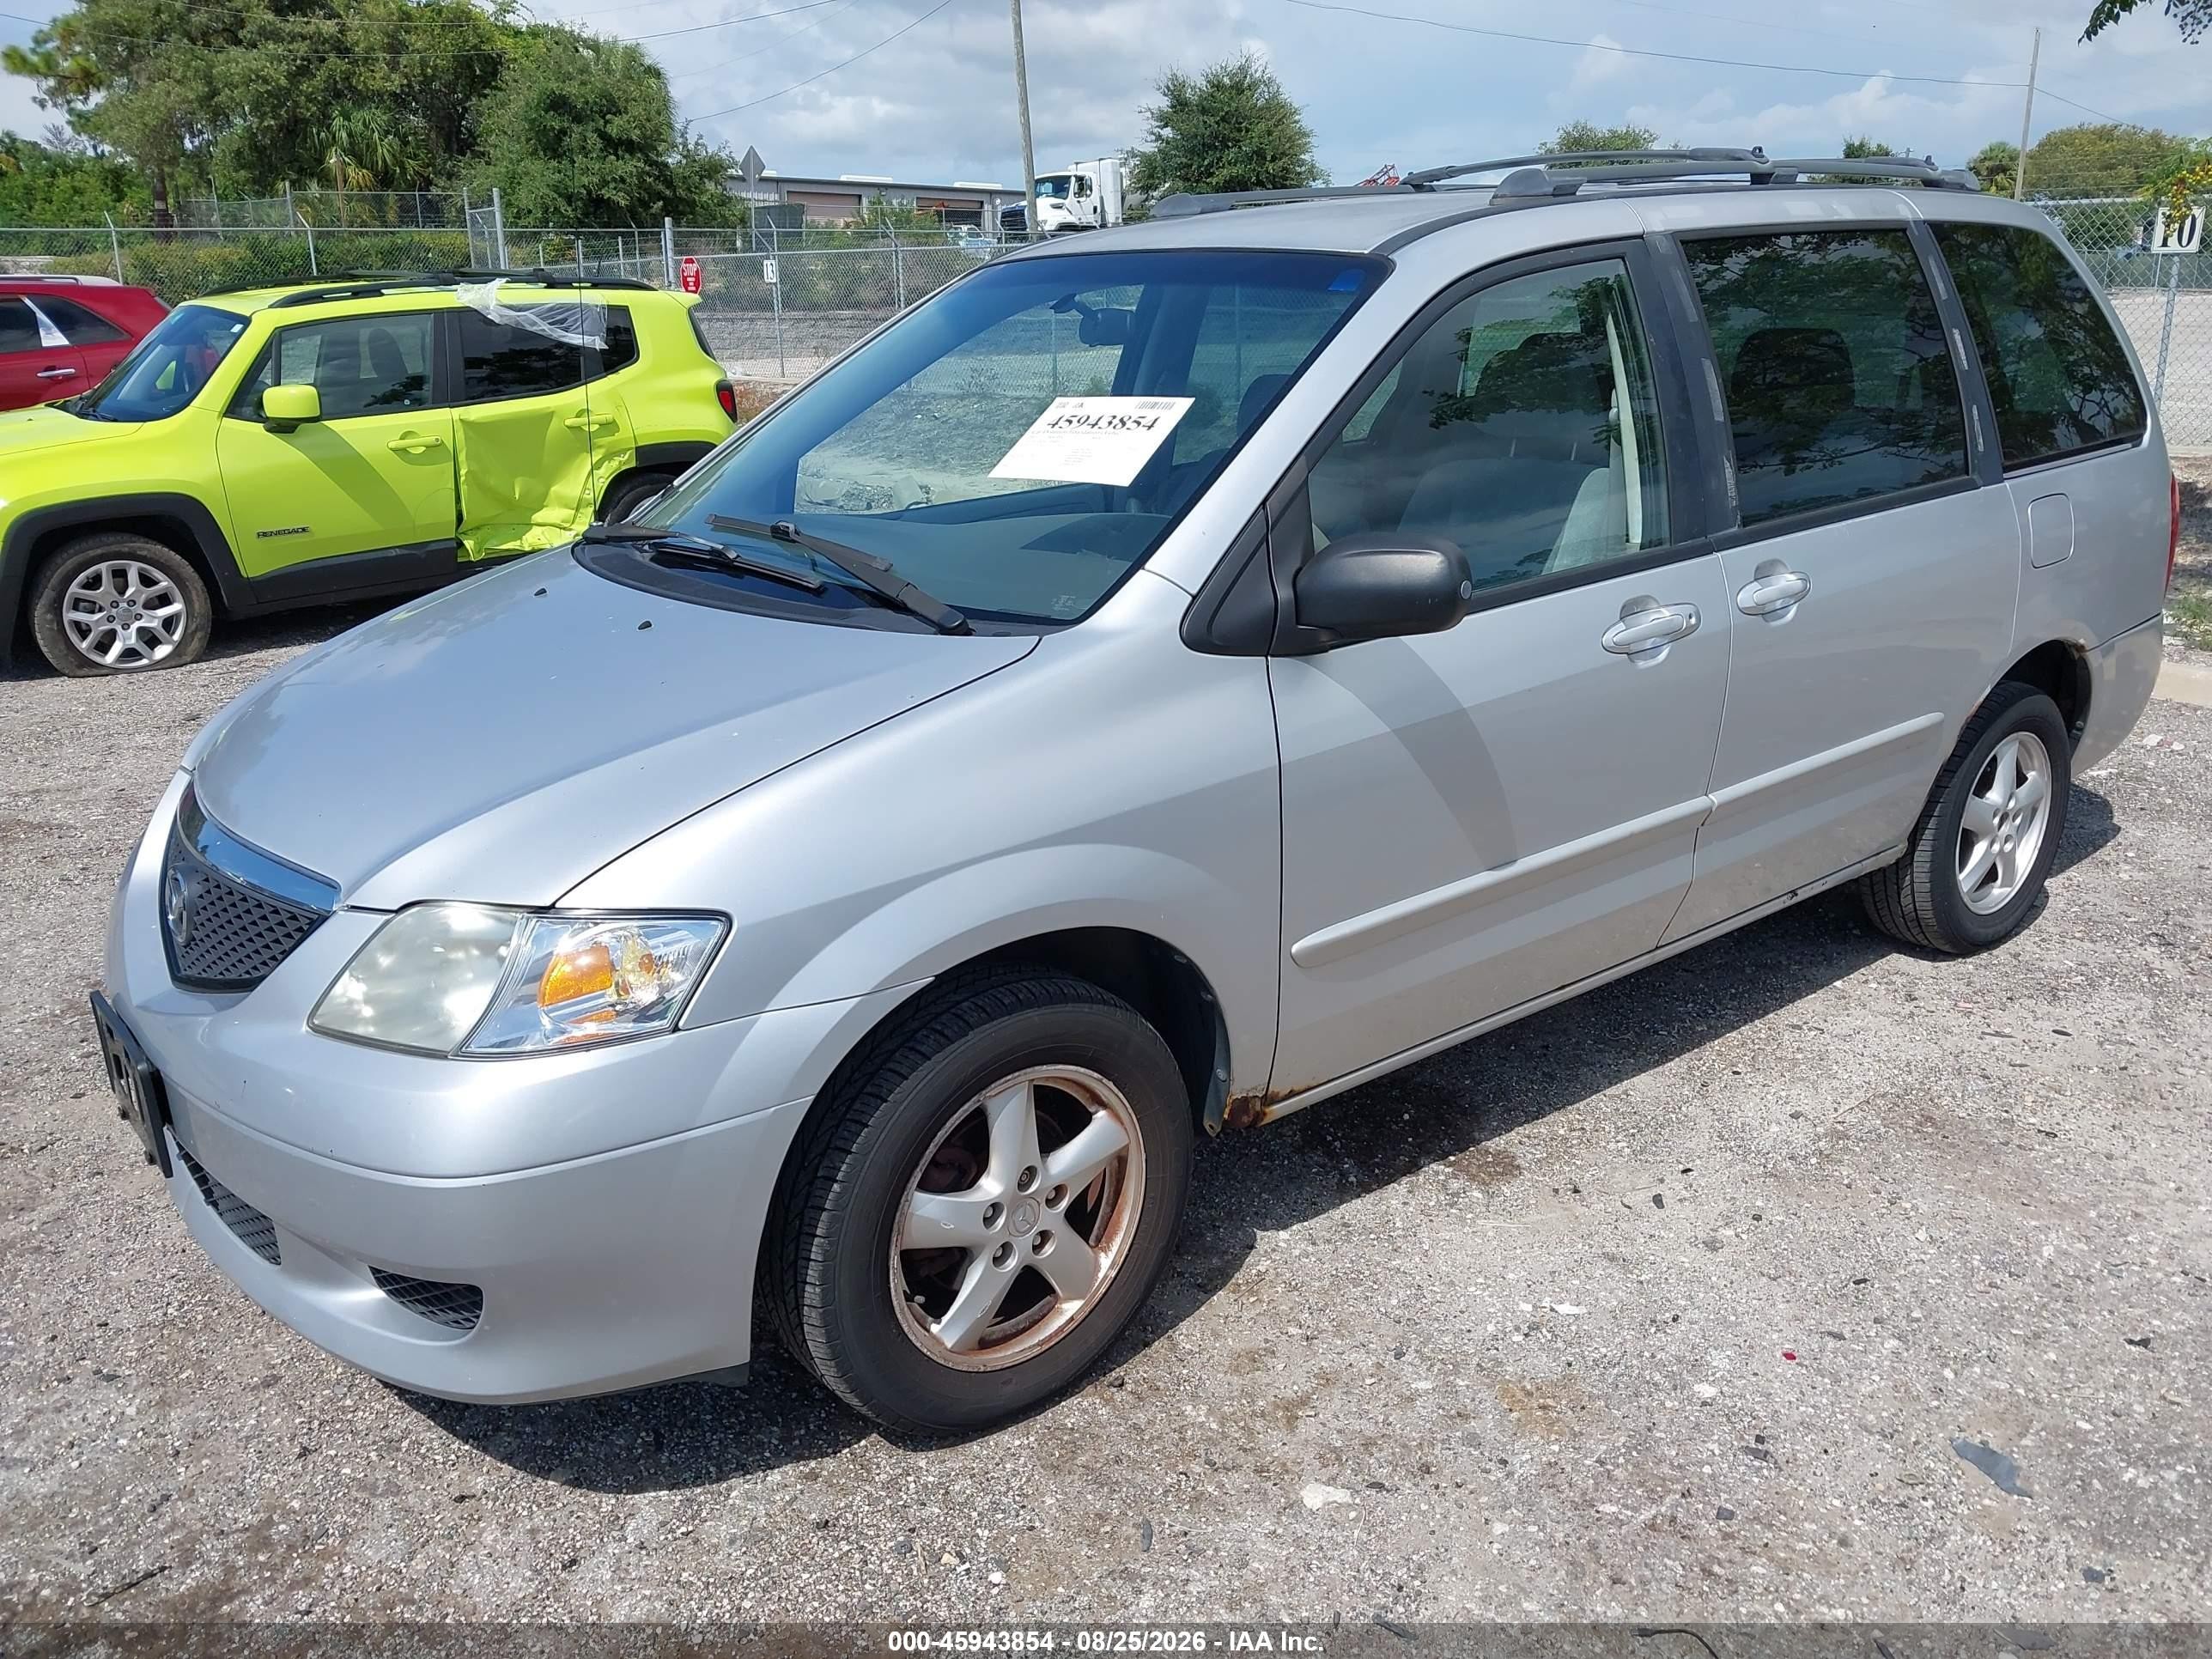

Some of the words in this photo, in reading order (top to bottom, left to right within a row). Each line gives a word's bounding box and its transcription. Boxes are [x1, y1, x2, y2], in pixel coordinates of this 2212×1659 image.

[683, 263, 697, 276] STOP
[765, 262, 775, 280] 13
[1047, 414, 1160, 431] 45943854
[257, 526, 310, 539] RENEGADE
